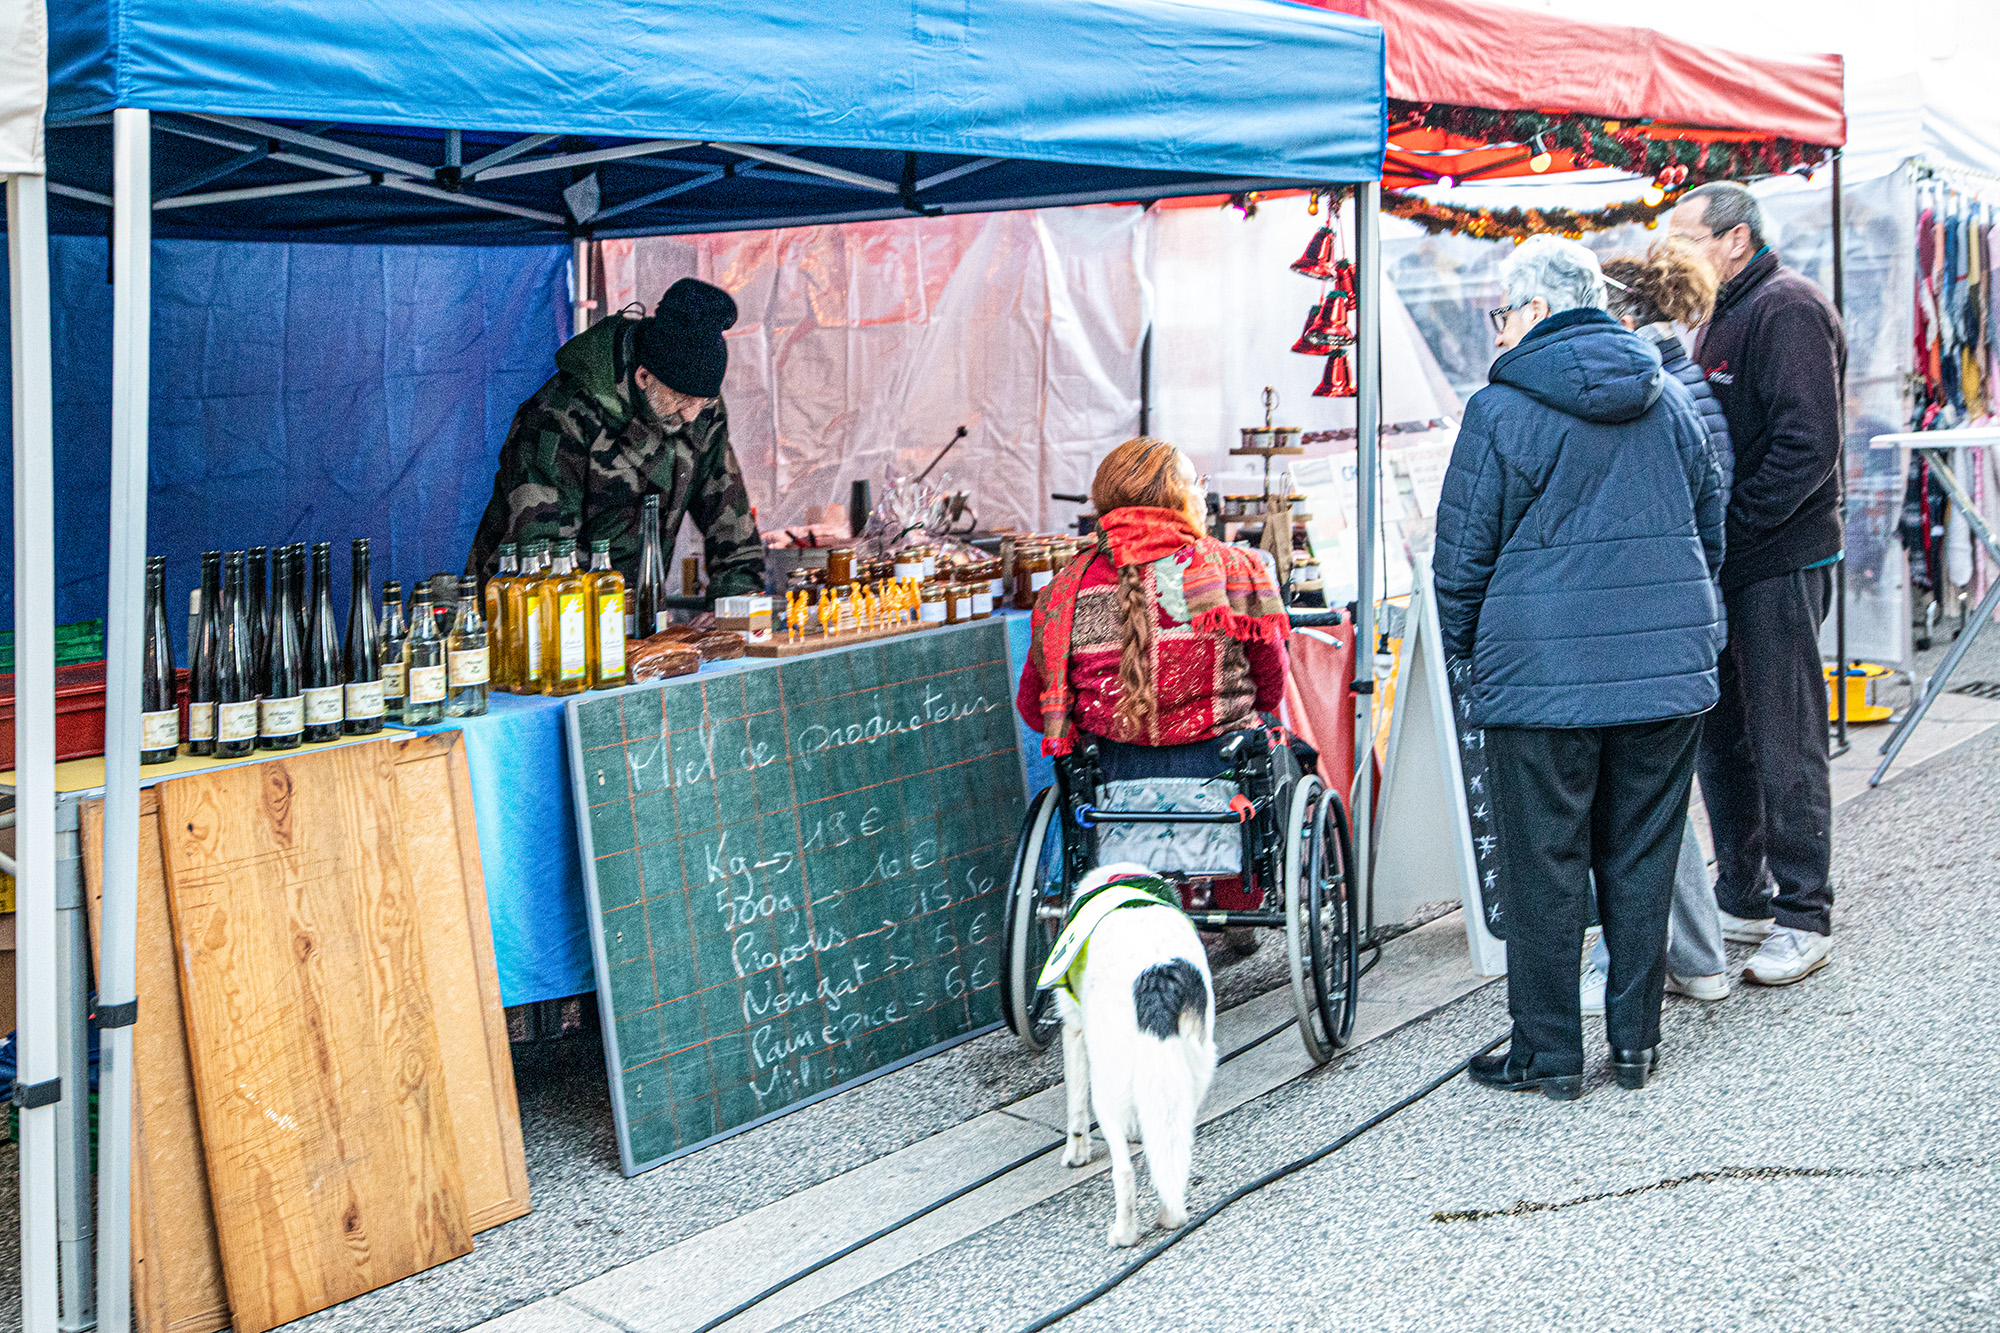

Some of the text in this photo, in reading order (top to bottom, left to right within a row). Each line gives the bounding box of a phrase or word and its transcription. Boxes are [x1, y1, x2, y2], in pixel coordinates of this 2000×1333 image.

[628, 710, 718, 791] Miel
[740, 719, 777, 771] de
[704, 830, 754, 901] Kg
[715, 887, 800, 934] 500g
[743, 957, 871, 1025] Nougat
[935, 921, 960, 958] 5
[945, 965, 966, 999] 6
